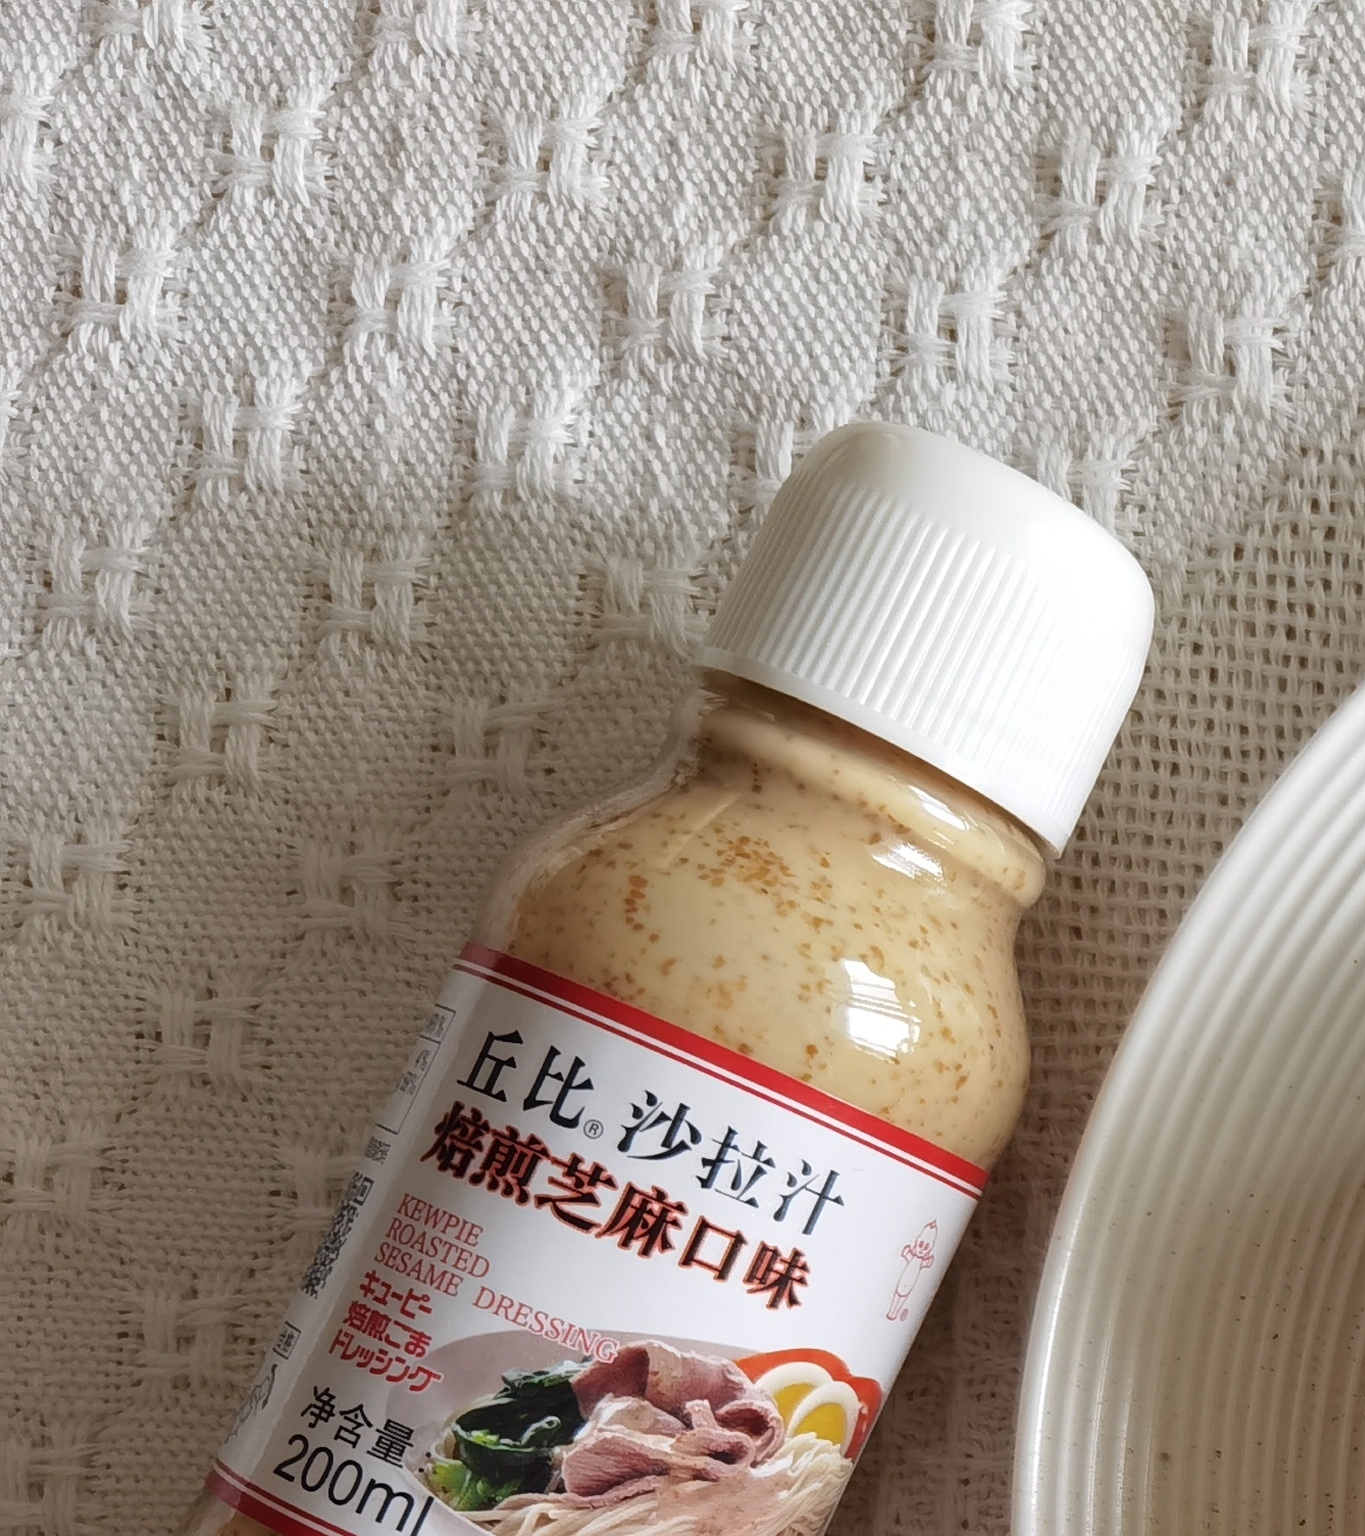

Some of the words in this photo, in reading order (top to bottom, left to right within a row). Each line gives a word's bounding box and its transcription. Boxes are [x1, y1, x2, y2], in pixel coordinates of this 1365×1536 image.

[396, 1192, 484, 1248] KEWPIE
[419, 1100, 811, 1311] 焙煎芝麻口味
[385, 1216, 491, 1279] ROASTED
[359, 1269, 433, 1320] キューピー
[373, 1241, 464, 1298] SESAME
[472, 1284, 620, 1364] DRESSING
